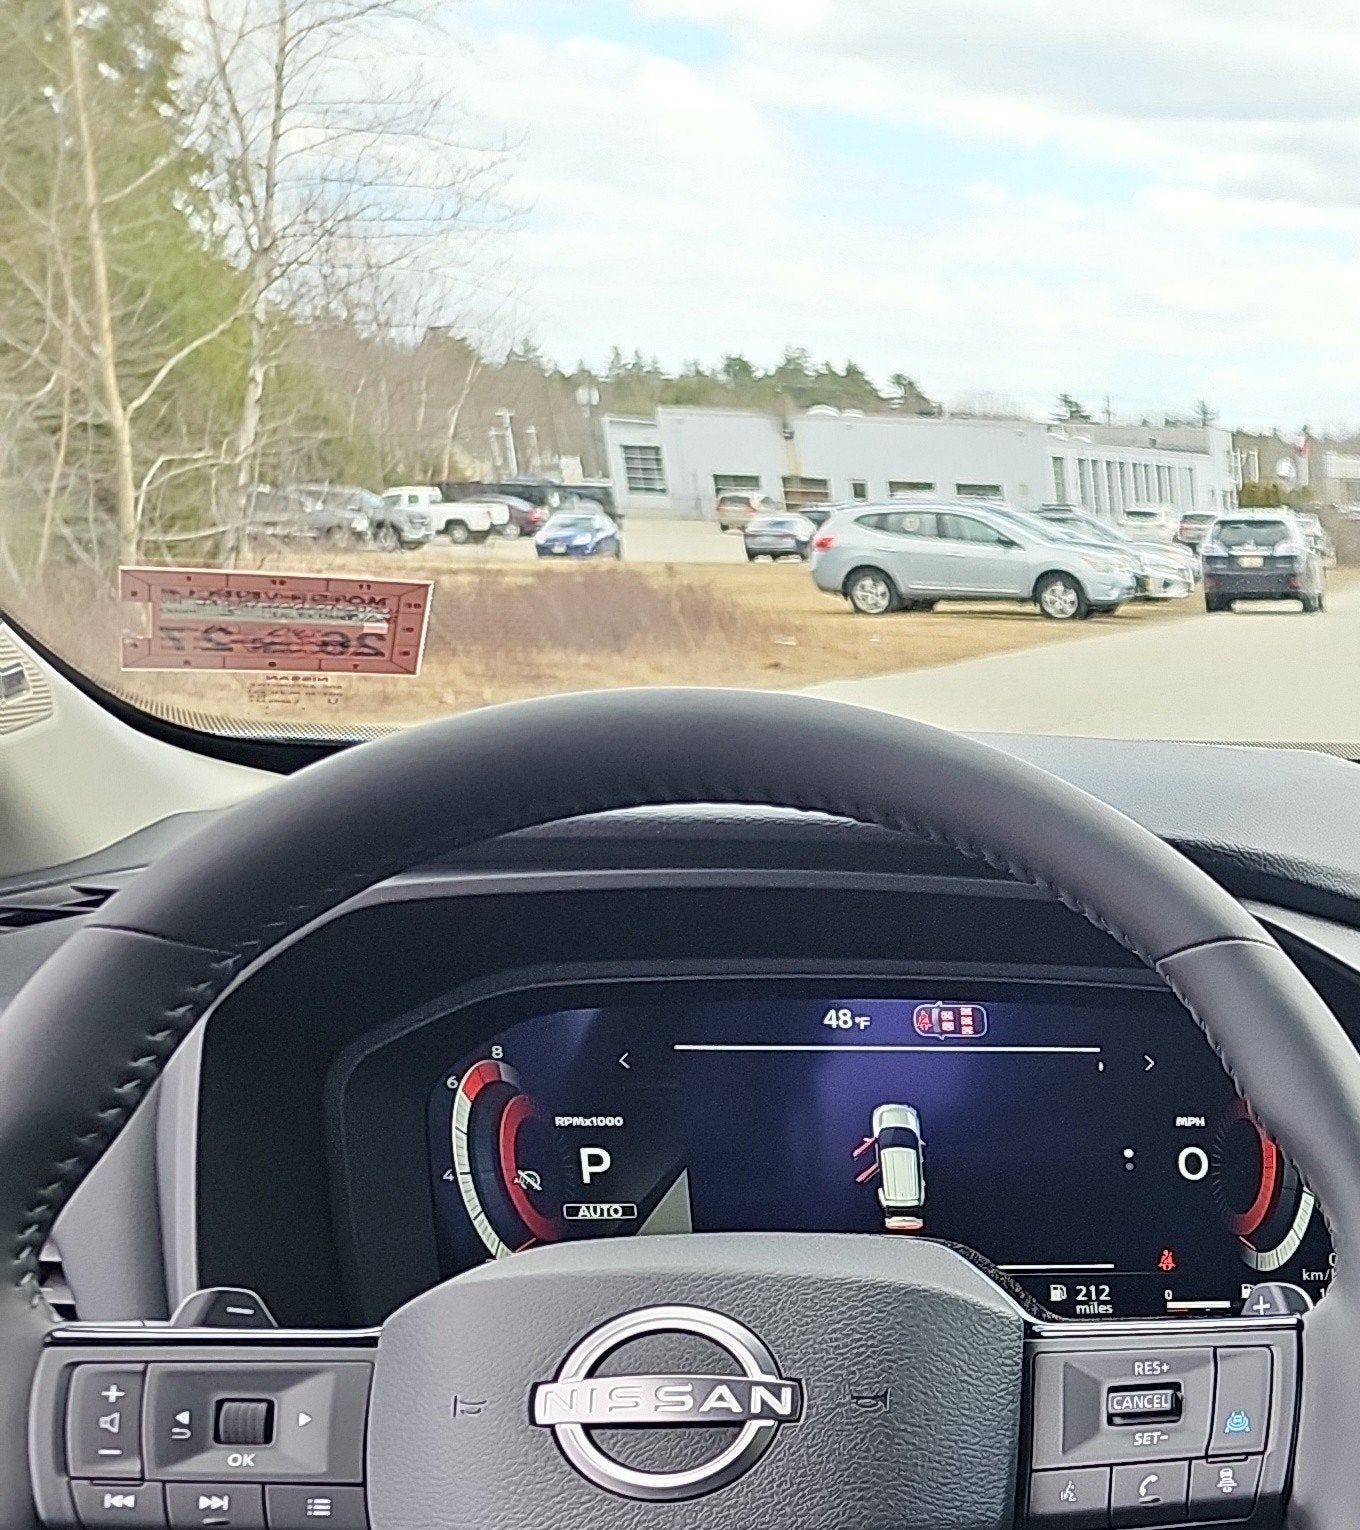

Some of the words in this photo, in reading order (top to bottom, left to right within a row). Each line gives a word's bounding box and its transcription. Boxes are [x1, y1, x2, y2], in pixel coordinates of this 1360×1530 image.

[491, 1046, 503, 1058] 8
[447, 1076, 458, 1089] 6
[1175, 1116, 1205, 1127] MPH
[580, 1147, 611, 1184] P
[1178, 1146, 1209, 1181] 0
[578, 1206, 623, 1218] AUTO
[1076, 1285, 1110, 1300] 212
[1076, 1303, 1114, 1314] miles
[1134, 1361, 1170, 1376] RES+
[542, 1383, 794, 1417] NISSAN
[1113, 1395, 1170, 1410] CANCEL
[226, 1453, 256, 1468] OK
